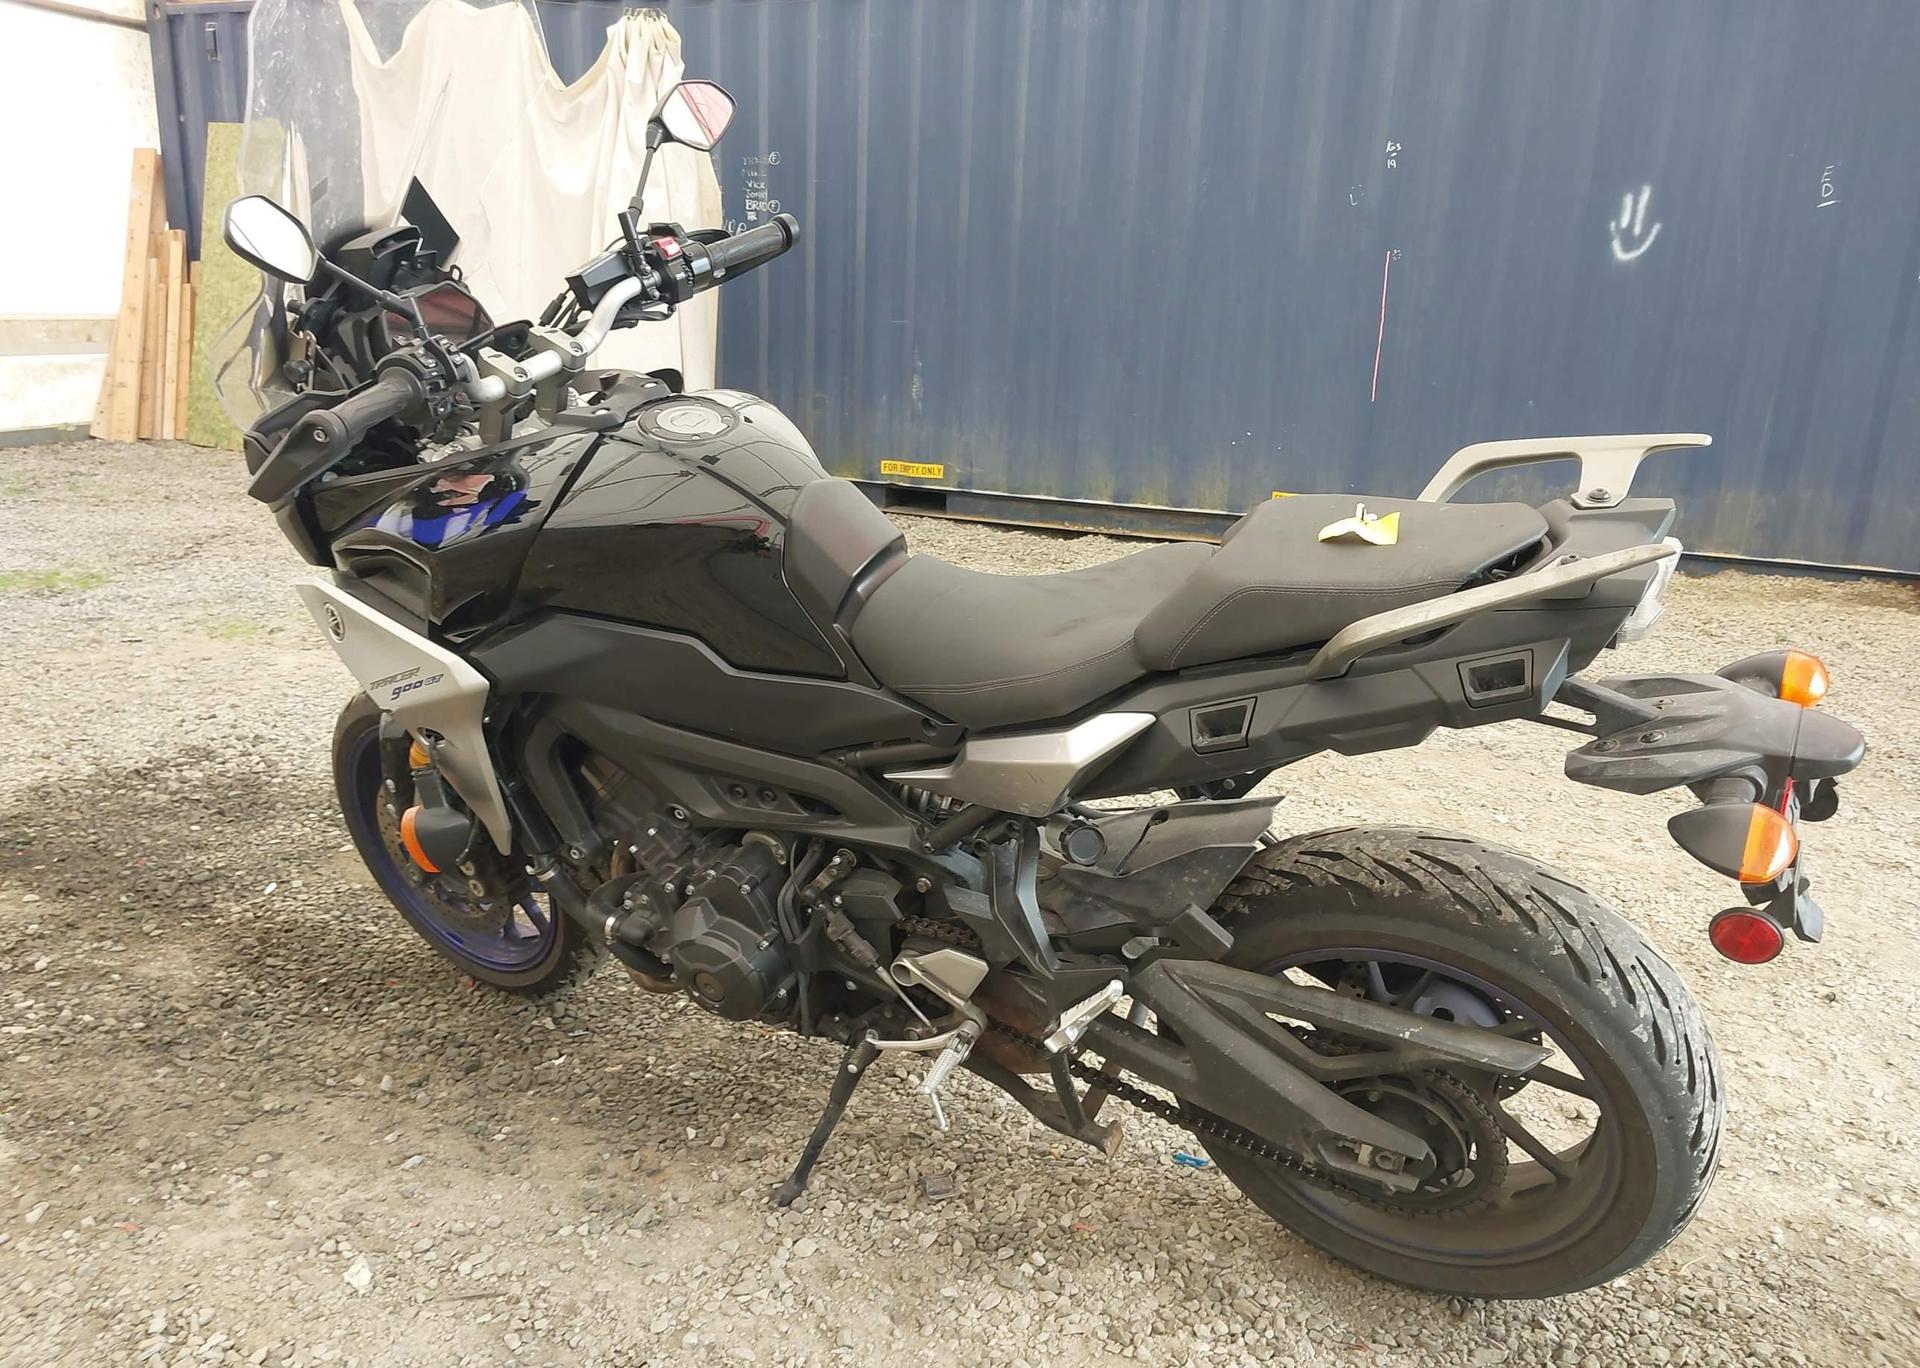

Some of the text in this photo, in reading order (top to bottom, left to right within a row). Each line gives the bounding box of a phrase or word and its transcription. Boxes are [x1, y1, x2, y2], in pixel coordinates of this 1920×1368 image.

[883, 462, 943, 477] FOR EMPTY ONLY
